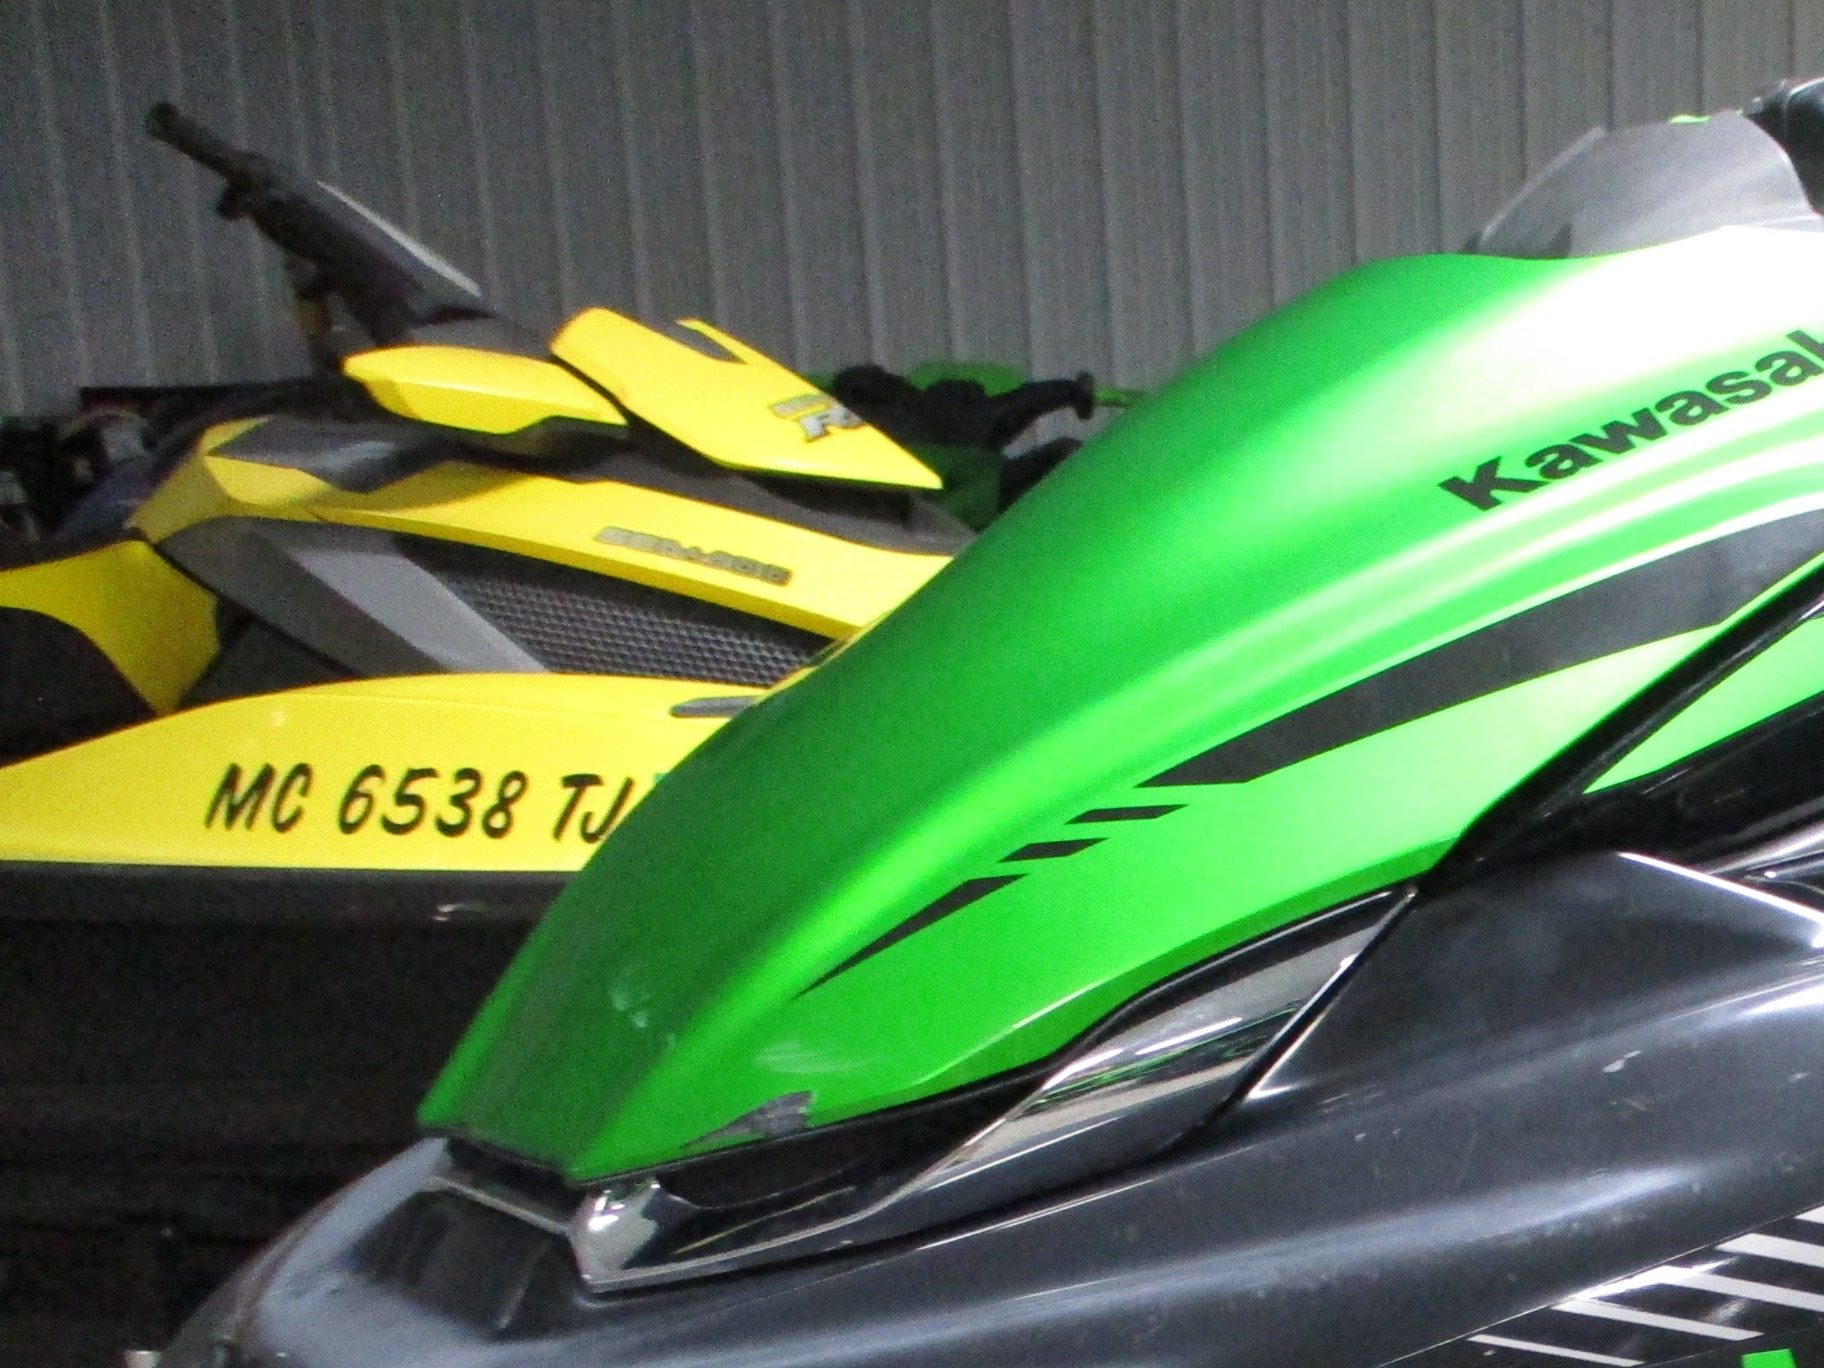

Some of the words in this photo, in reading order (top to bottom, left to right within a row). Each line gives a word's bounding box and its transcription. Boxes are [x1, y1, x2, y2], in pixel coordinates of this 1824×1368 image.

[204, 762, 314, 834] MC
[337, 764, 529, 840] 6538
[552, 773, 635, 844] TJ
